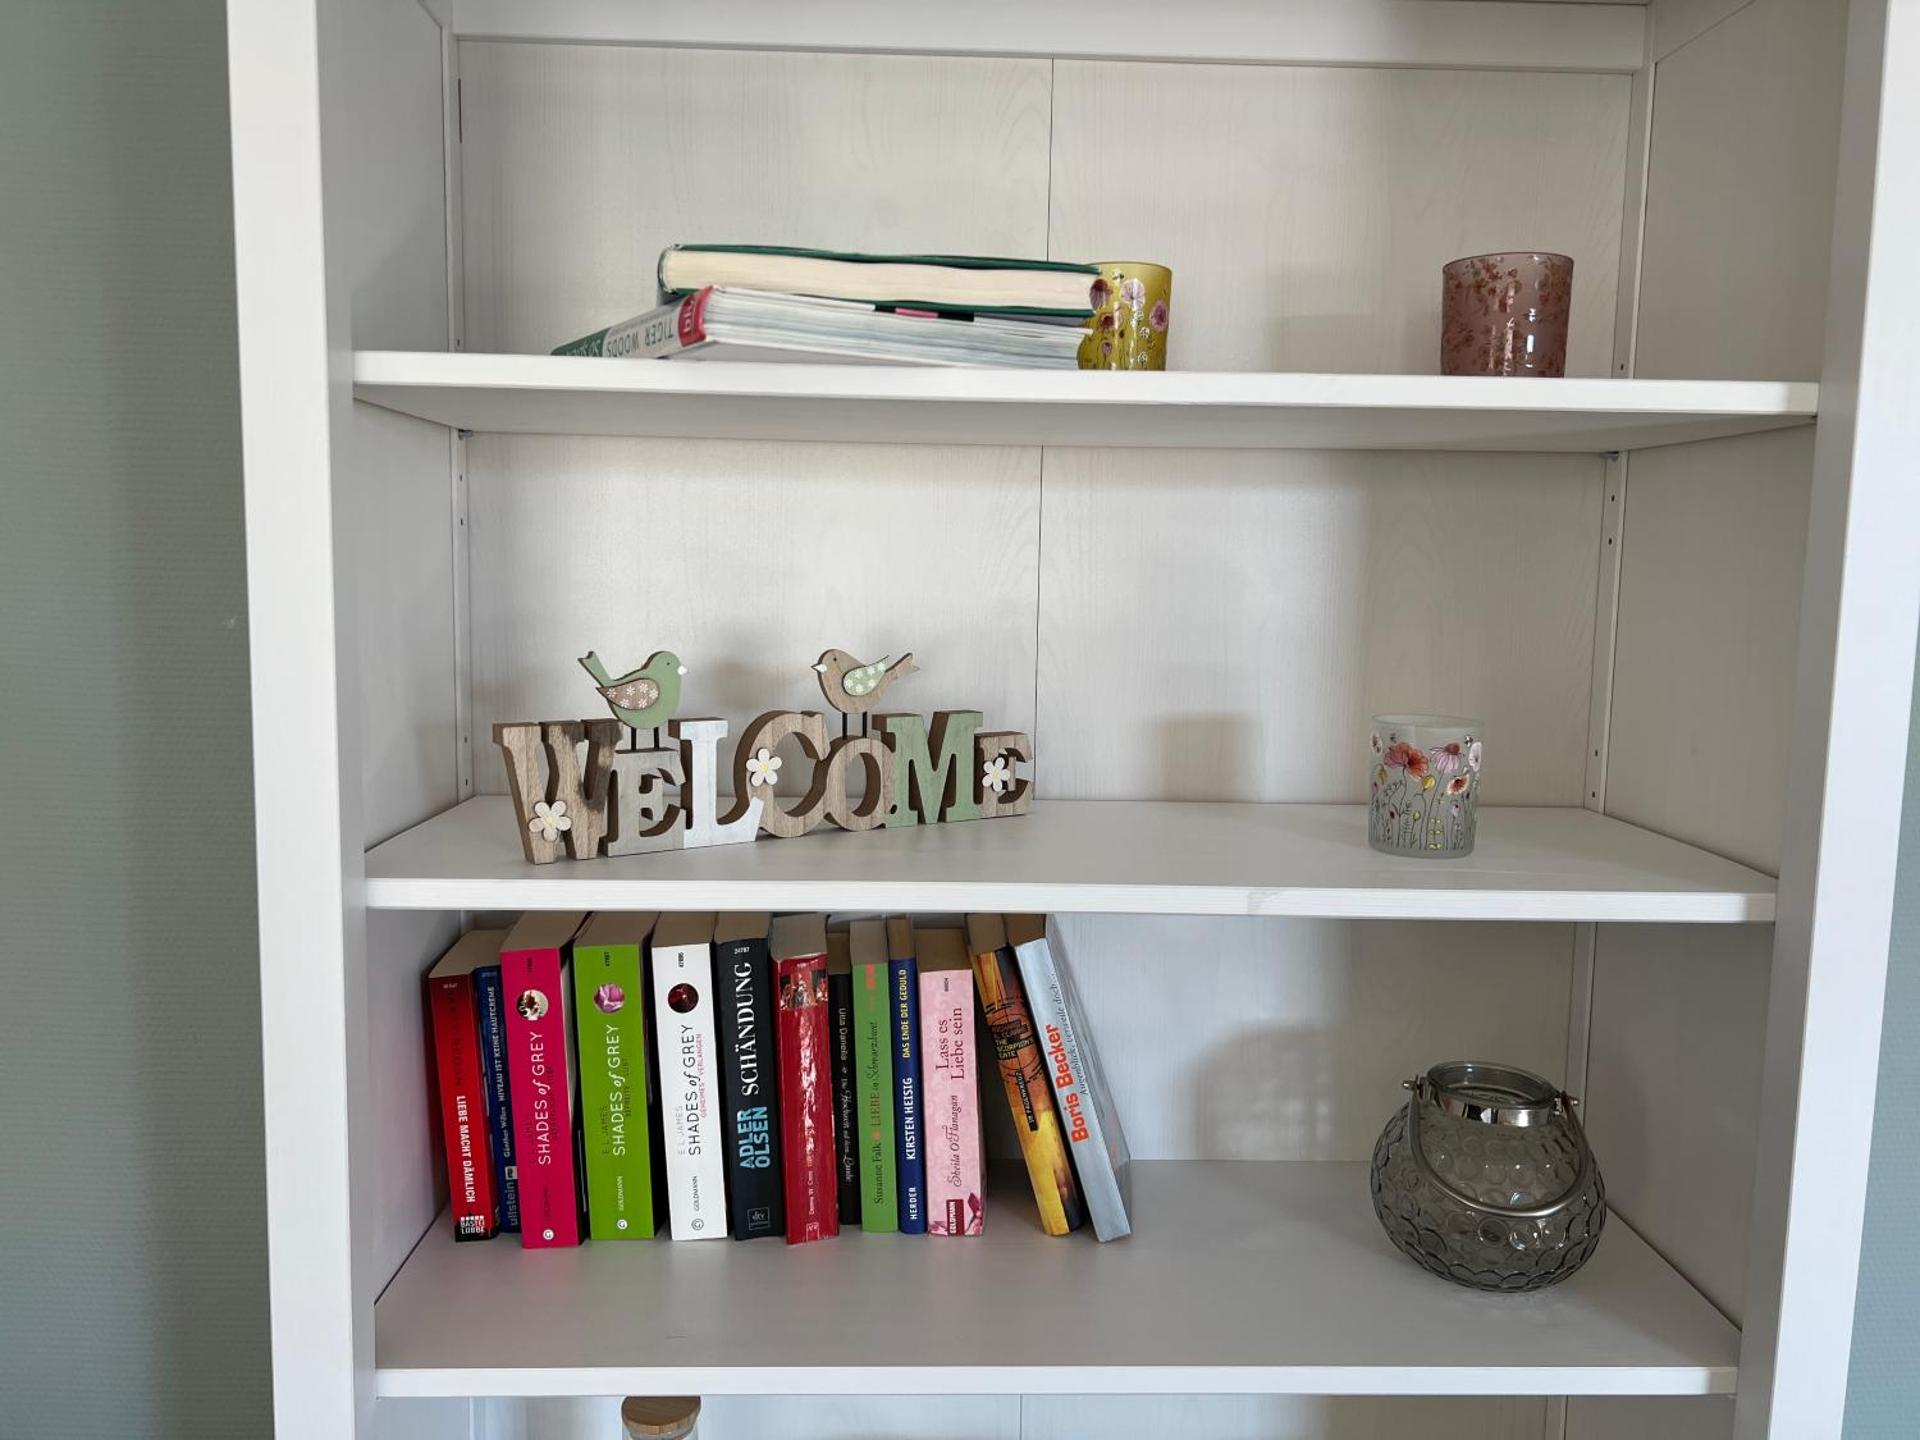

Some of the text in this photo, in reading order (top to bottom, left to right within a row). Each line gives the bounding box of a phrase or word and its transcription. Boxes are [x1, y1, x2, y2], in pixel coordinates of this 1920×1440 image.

[607, 331, 639, 357] WOODS
[645, 318, 674, 346] TIGER
[493, 710, 1034, 865] WELCOME
[487, 985, 499, 1034] HAUTCREME
[734, 961, 760, 1096] SCHÄNDUNG
[898, 969, 911, 1059] DAS ENDE DER GEDULD
[492, 1034, 501, 1058] KEINE
[494, 1059, 502, 1072] IST
[530, 1031, 545, 1076] GREY
[935, 1019, 949, 1070] Lass es
[949, 1007, 964, 1080] Liebe sein
[496, 1073, 505, 1102] NIVEAU
[532, 1078, 551, 1095] of
[606, 1024, 626, 1156] SHADES of GREY
[681, 1024, 701, 1156] SHADES of GREY
[1045, 1023, 1090, 1143] Boris Becker
[1069, 1044, 1089, 1096] Augenblick,
[534, 1099, 551, 1165] SHADES
[870, 1092, 881, 1127] LIEBE
[902, 1077, 916, 1160] KIRSTEN HEISIG
[456, 1095, 476, 1203] LIEBE MACHT DÄMLICH
[737, 1108, 755, 1169] ADLER
[751, 1106, 771, 1169] OLSEN
[691, 1175, 700, 1212] GOLDMANN
[872, 1142, 884, 1205] Susanne Falk
[947, 1153, 962, 1188] Sheila
[505, 1181, 518, 1226] ullstein
[908, 1187, 918, 1220] HERDER
[949, 1201, 957, 1234] GOLDMANN
